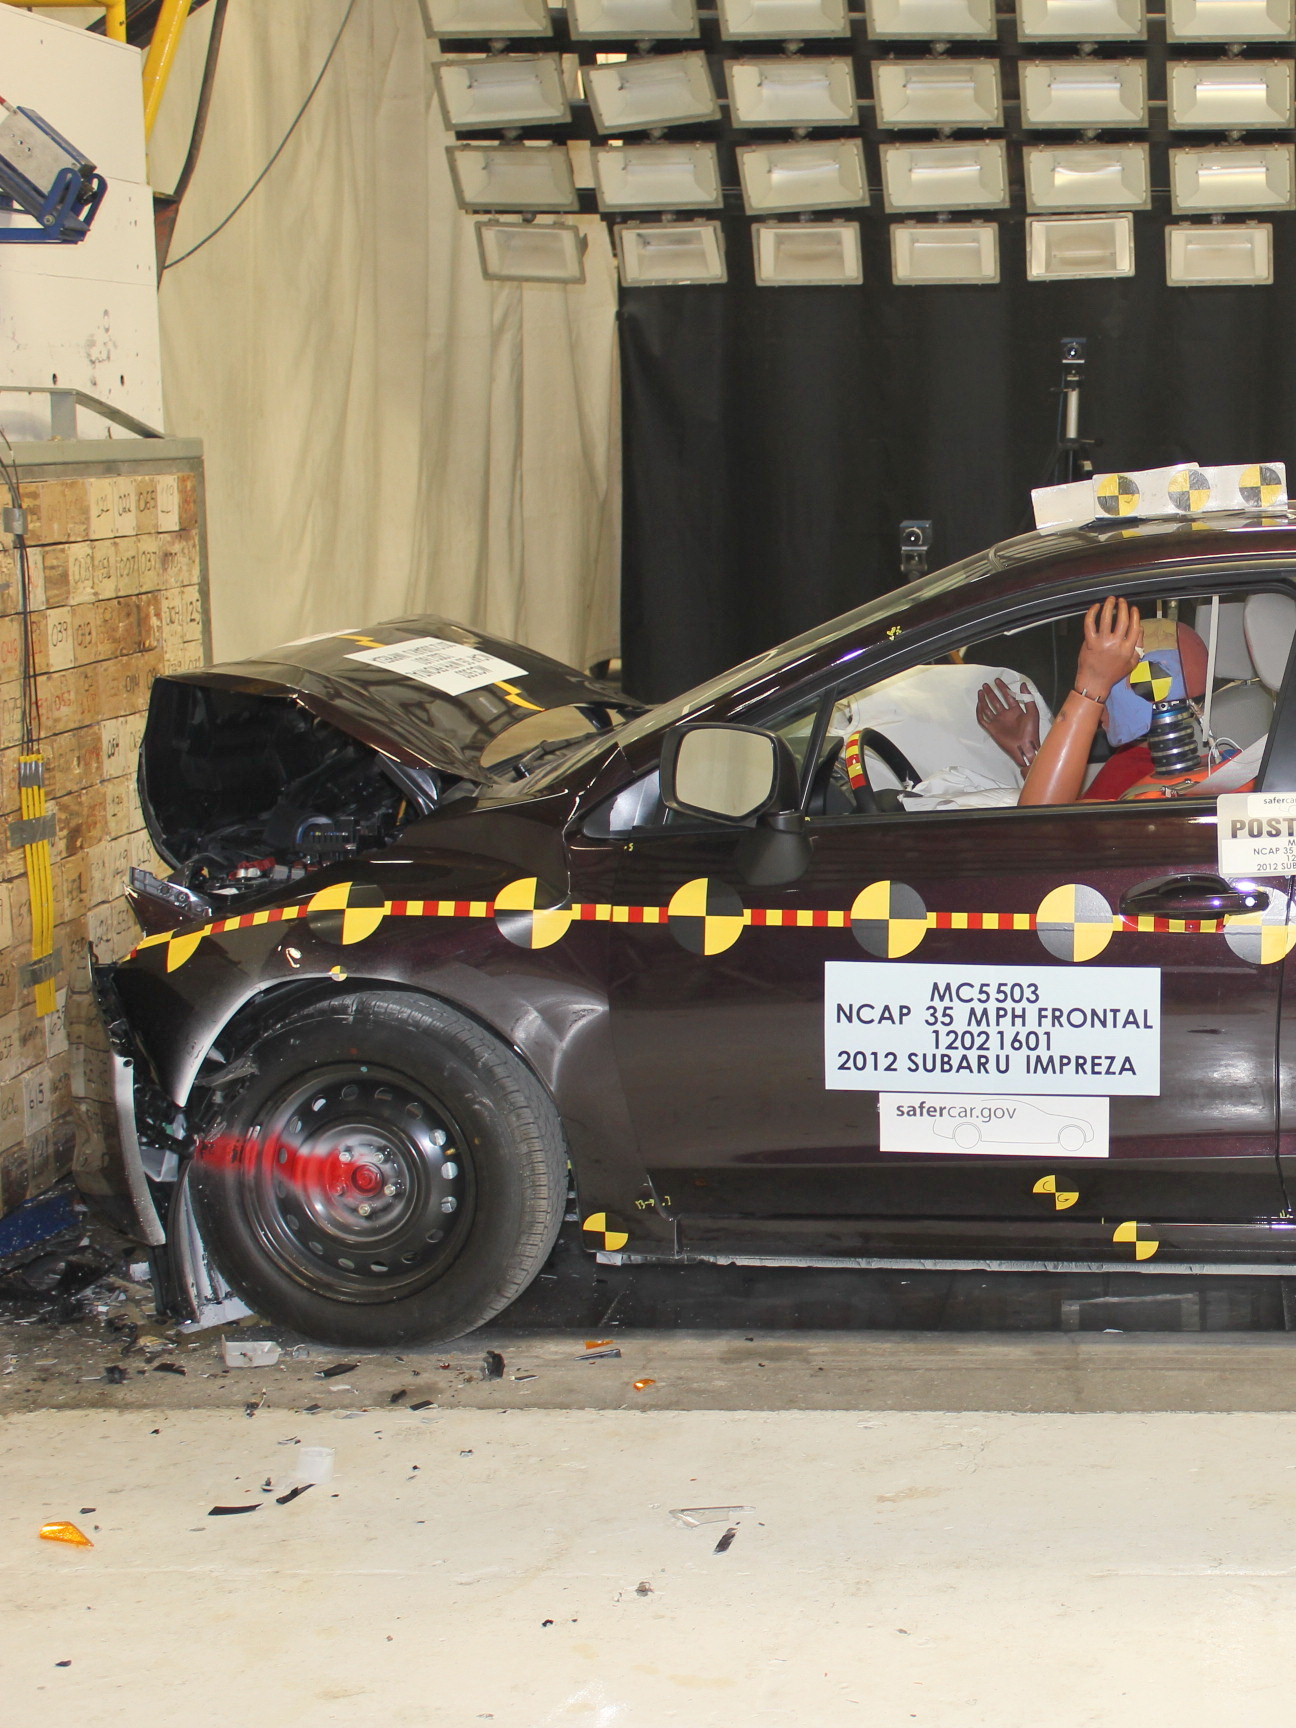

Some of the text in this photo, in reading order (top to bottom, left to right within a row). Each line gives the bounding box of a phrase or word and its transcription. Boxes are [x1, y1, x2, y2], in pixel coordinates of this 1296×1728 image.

[141, 551, 157, 574] 037
[51, 621, 68, 648] 039
[1257, 863, 1278, 871] 2012
[929, 981, 1040, 1004] MC5503
[836, 1003, 1154, 1030] NCAP 35 MPH FRONTAL
[931, 1030, 1051, 1051] 12021601
[837, 1051, 1137, 1076] 2012 SUBARU IMPREZA
[29, 1083, 44, 1109] 615
[896, 1101, 1017, 1123] safercar.gov
